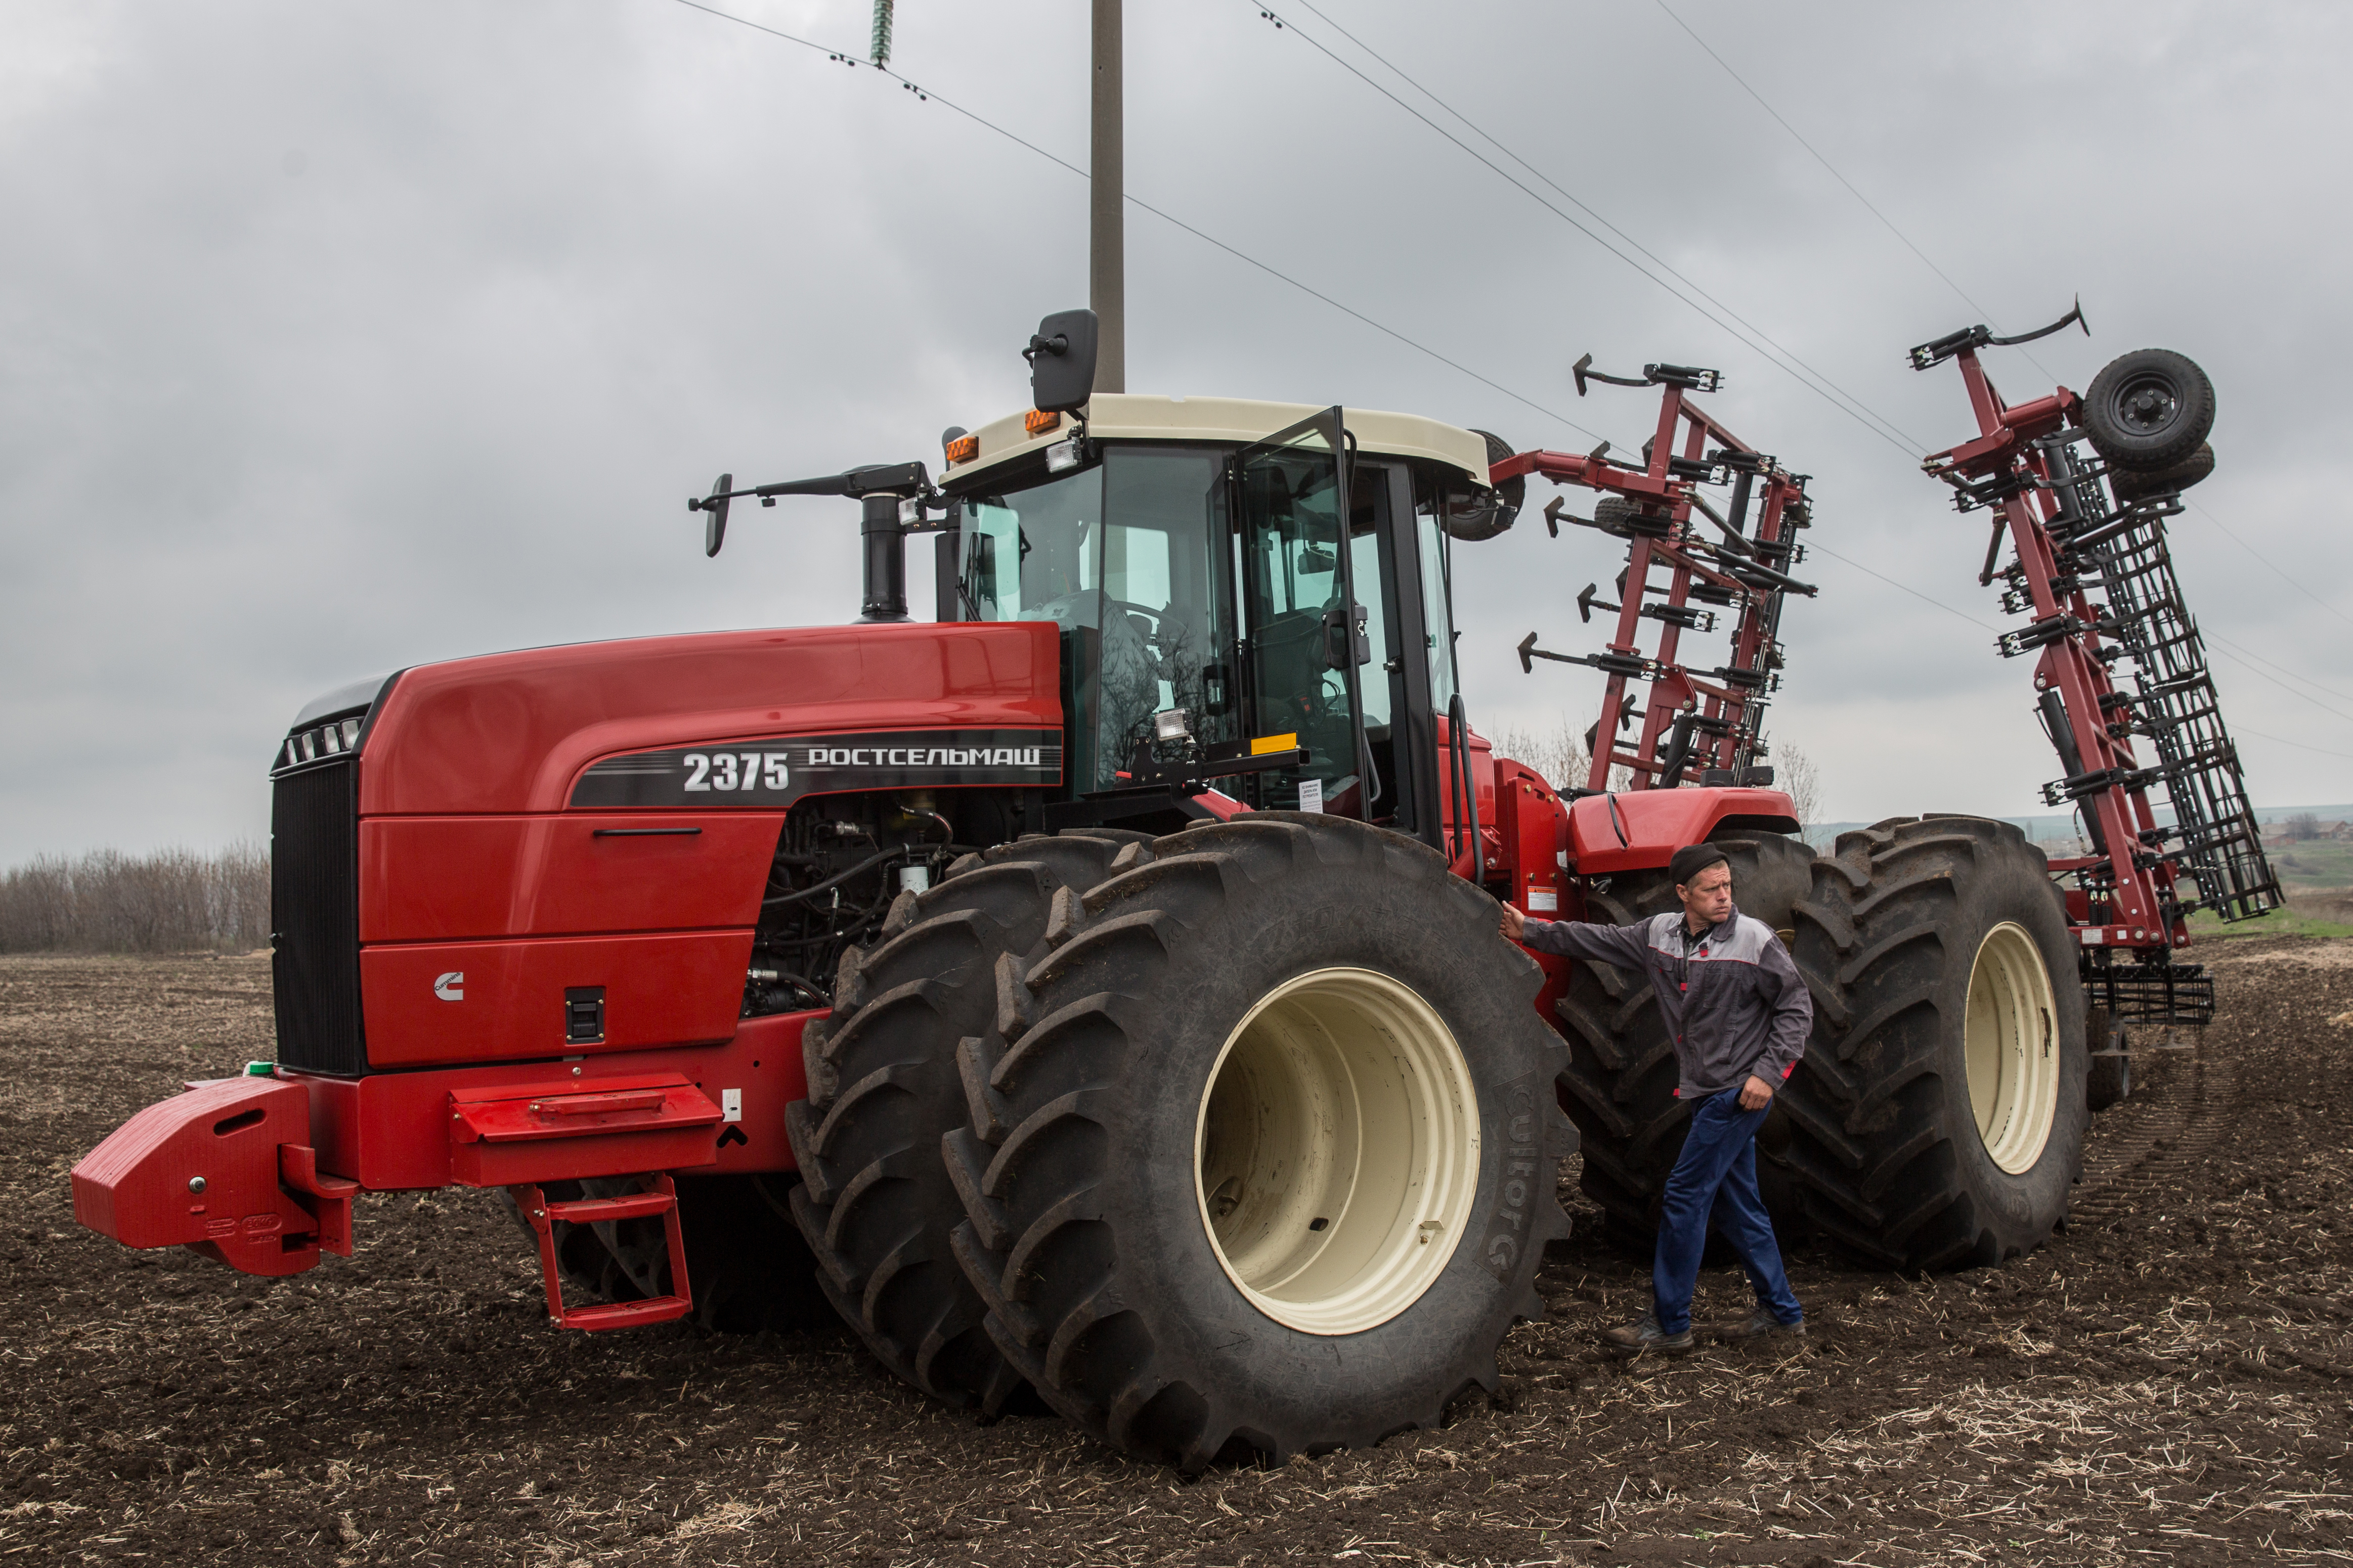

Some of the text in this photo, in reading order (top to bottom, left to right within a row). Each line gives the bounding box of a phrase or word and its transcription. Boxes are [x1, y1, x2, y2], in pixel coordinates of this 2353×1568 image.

[808, 748, 1040, 765] РОСТСЕЛЬМАШ
[683, 752, 789, 791] 2375
[434, 972, 461, 991] Cummins
[1499, 1084, 1538, 1232] Cultor
